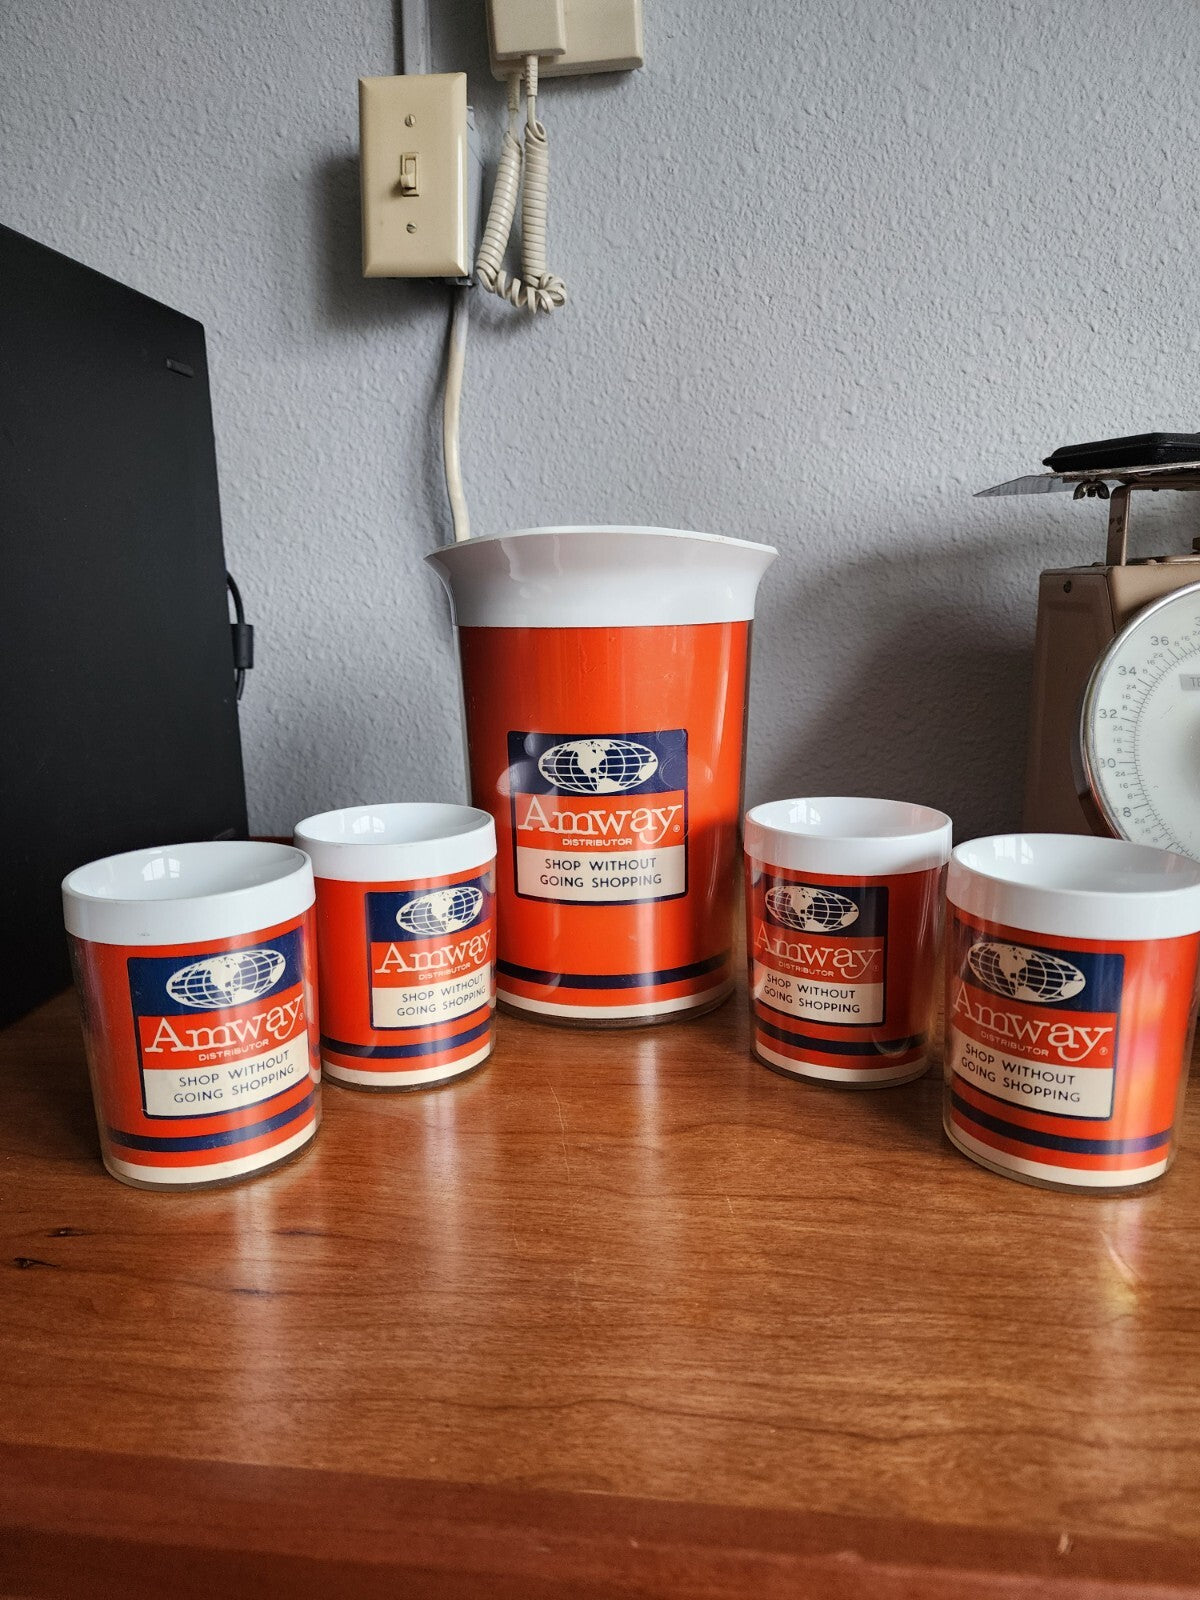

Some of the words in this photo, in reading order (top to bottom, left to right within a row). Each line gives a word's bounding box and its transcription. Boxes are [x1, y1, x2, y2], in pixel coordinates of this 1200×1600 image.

[1151, 636, 1169, 646] 36
[1118, 666, 1137, 676] 34
[1099, 708, 1118, 719] 32
[1099, 757, 1116, 768] 30
[517, 795, 682, 844] Amway
[562, 837, 633, 847] DISTRIBUTOR
[545, 858, 581, 870] SHOP
[589, 858, 657, 871] WITHOUT
[540, 874, 584, 888] GOING
[592, 874, 662, 888] SHOPPING
[374, 929, 491, 974] Amway
[754, 921, 882, 979] Amway
[418, 962, 471, 980] DISTRIBUTOR
[778, 961, 834, 978] DISTRIBUTOR
[402, 990, 434, 1003] SHOP
[441, 973, 483, 996] WITHOUT
[763, 985, 793, 1004] GOING
[798, 998, 861, 1013] SHOPPING
[766, 973, 792, 989] SHOP
[796, 984, 856, 999] WITHOUT
[396, 1004, 437, 1016] GOING
[442, 986, 486, 1011] SHOPPING
[145, 993, 304, 1053] Amway
[953, 981, 1113, 1062] Amway
[198, 1039, 269, 1062] DISTRIBUTOR
[980, 1030, 1050, 1057] DISTRIBUTOR
[179, 1073, 220, 1087] SHOP
[228, 1050, 290, 1080] WITHOUT
[965, 1043, 995, 1065] SHOP
[1002, 1060, 1076, 1085] WITHOUT
[174, 1088, 223, 1104] GOING
[232, 1064, 294, 1096] SHOPPING
[961, 1056, 996, 1082] GOING
[1003, 1077, 1081, 1103] SHOPPING
